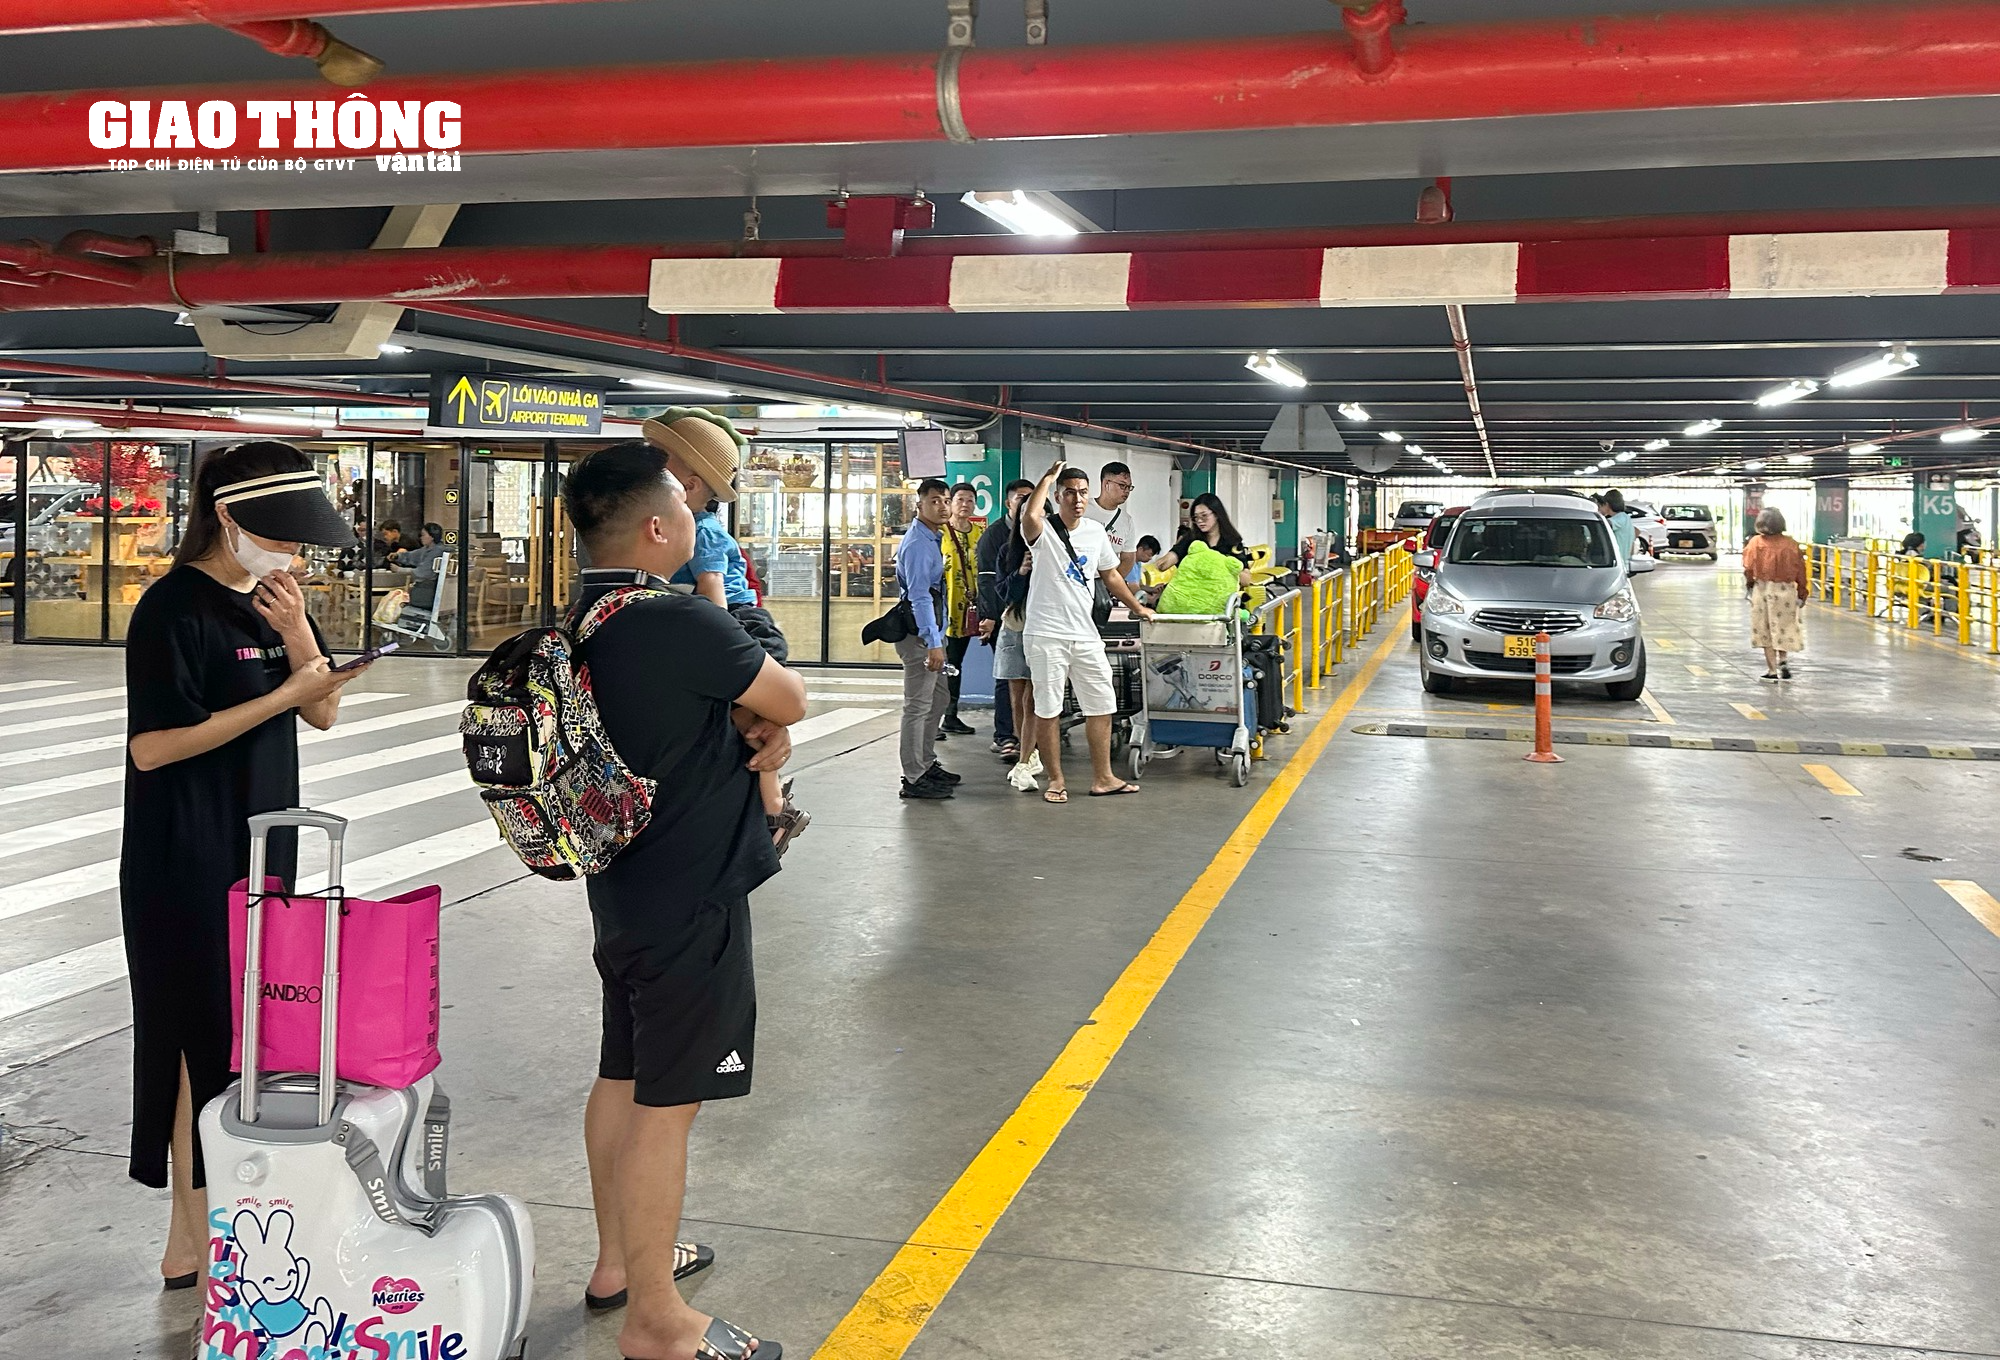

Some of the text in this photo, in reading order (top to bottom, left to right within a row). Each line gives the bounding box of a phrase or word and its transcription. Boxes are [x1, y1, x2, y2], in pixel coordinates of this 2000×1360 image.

[533, 385, 558, 406] VÀO
[558, 388, 582, 408] NHÀ
[582, 392, 599, 409] GA
[509, 410, 590, 427] AIRPORT TERMINAL
[1816, 496, 1844, 512] M5
[1922, 494, 1954, 516] K5
[1198, 673, 1233, 682] DORCO
[715, 1062, 746, 1074] adidas
[372, 1288, 425, 1307] Merries
